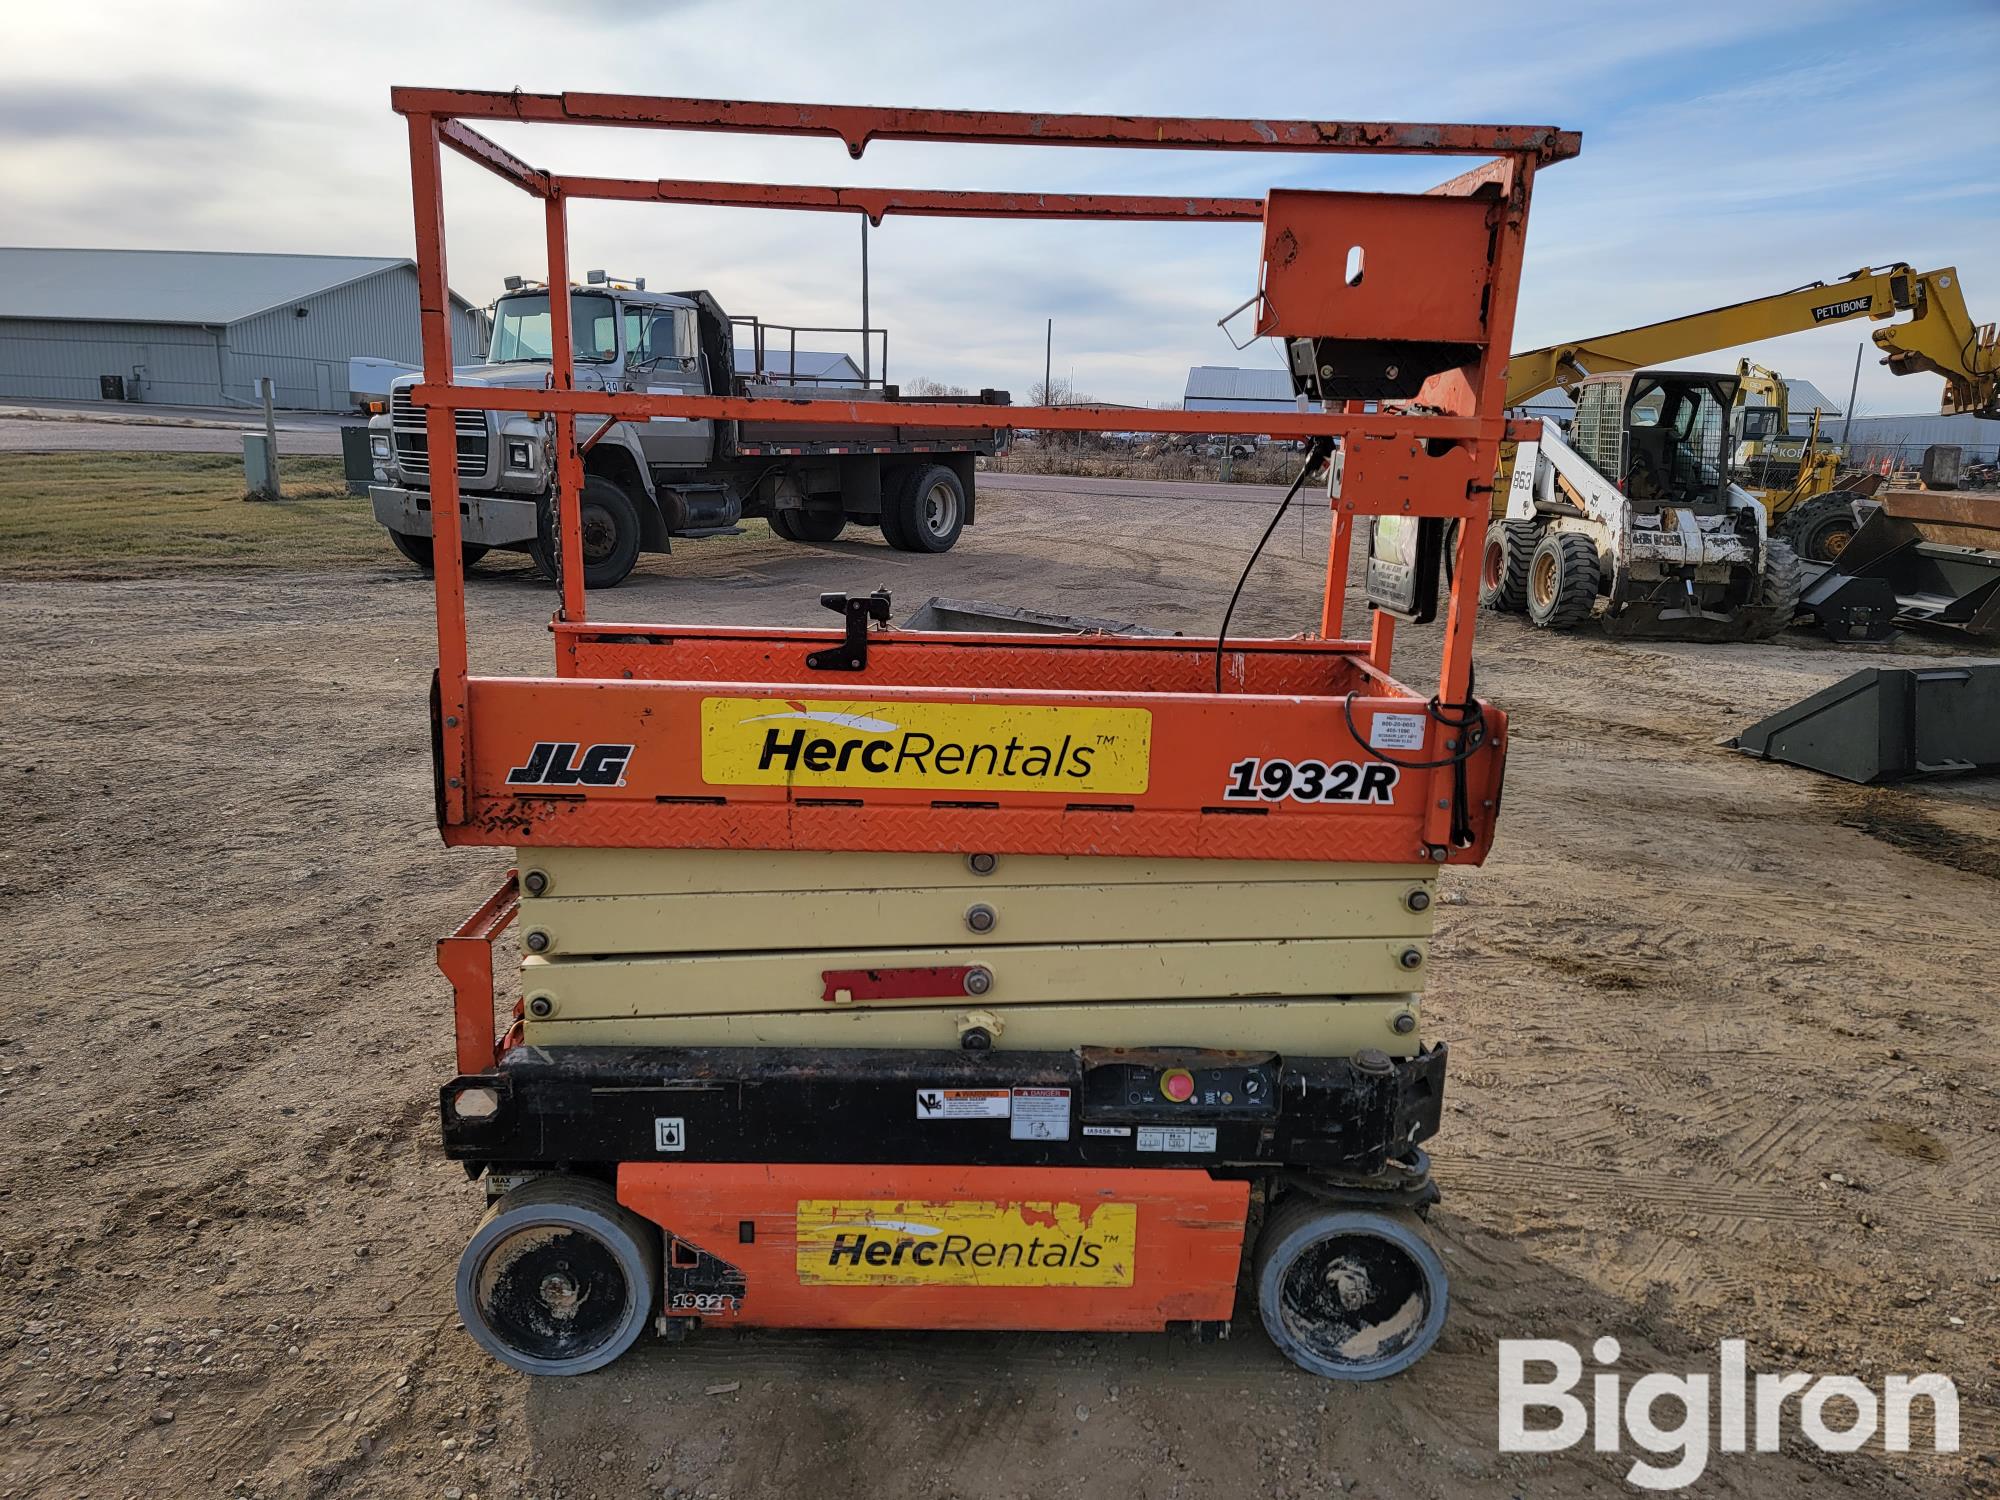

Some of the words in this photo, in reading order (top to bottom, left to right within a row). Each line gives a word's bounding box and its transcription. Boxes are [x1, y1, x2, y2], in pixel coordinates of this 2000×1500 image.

[1816, 298, 1869, 319] PETTIBONE
[1513, 470, 1532, 490] 863
[1225, 759, 1398, 803] 1932R
